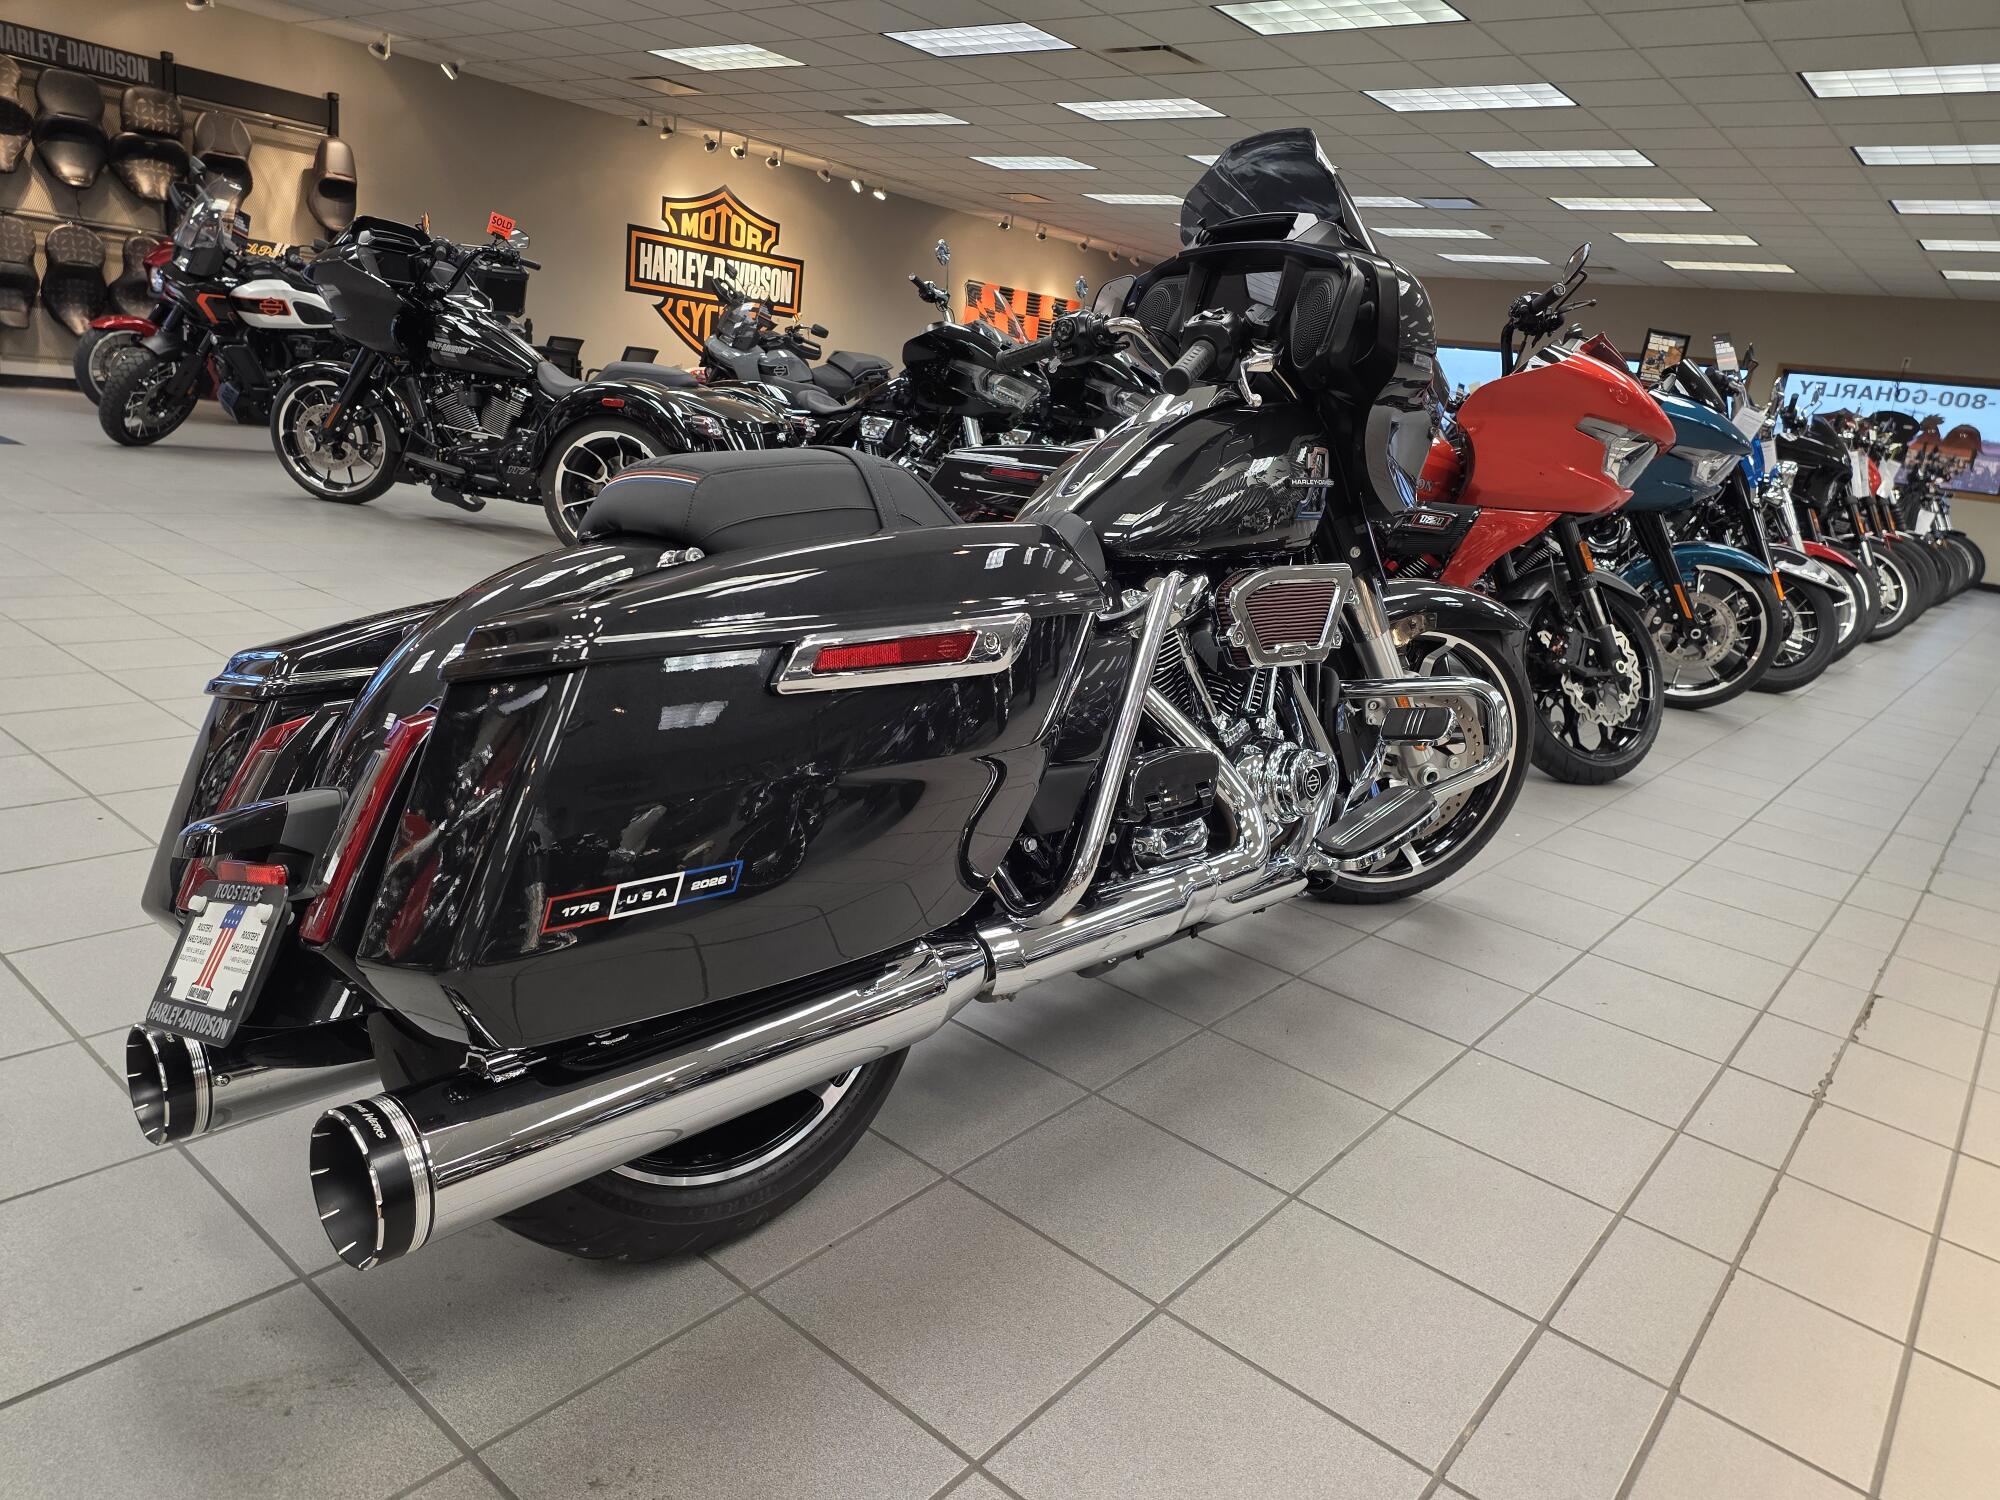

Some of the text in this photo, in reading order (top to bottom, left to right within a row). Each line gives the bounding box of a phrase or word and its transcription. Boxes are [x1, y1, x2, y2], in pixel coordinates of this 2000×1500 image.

[491, 215, 513, 230] SOLD
[681, 203, 763, 252] MOTOR
[214, 883, 264, 902] ROOSTER'S
[561, 901, 601, 918] 1776
[690, 874, 728, 891] 2026
[147, 1000, 233, 1040] HARLEY-DAVIDSON
